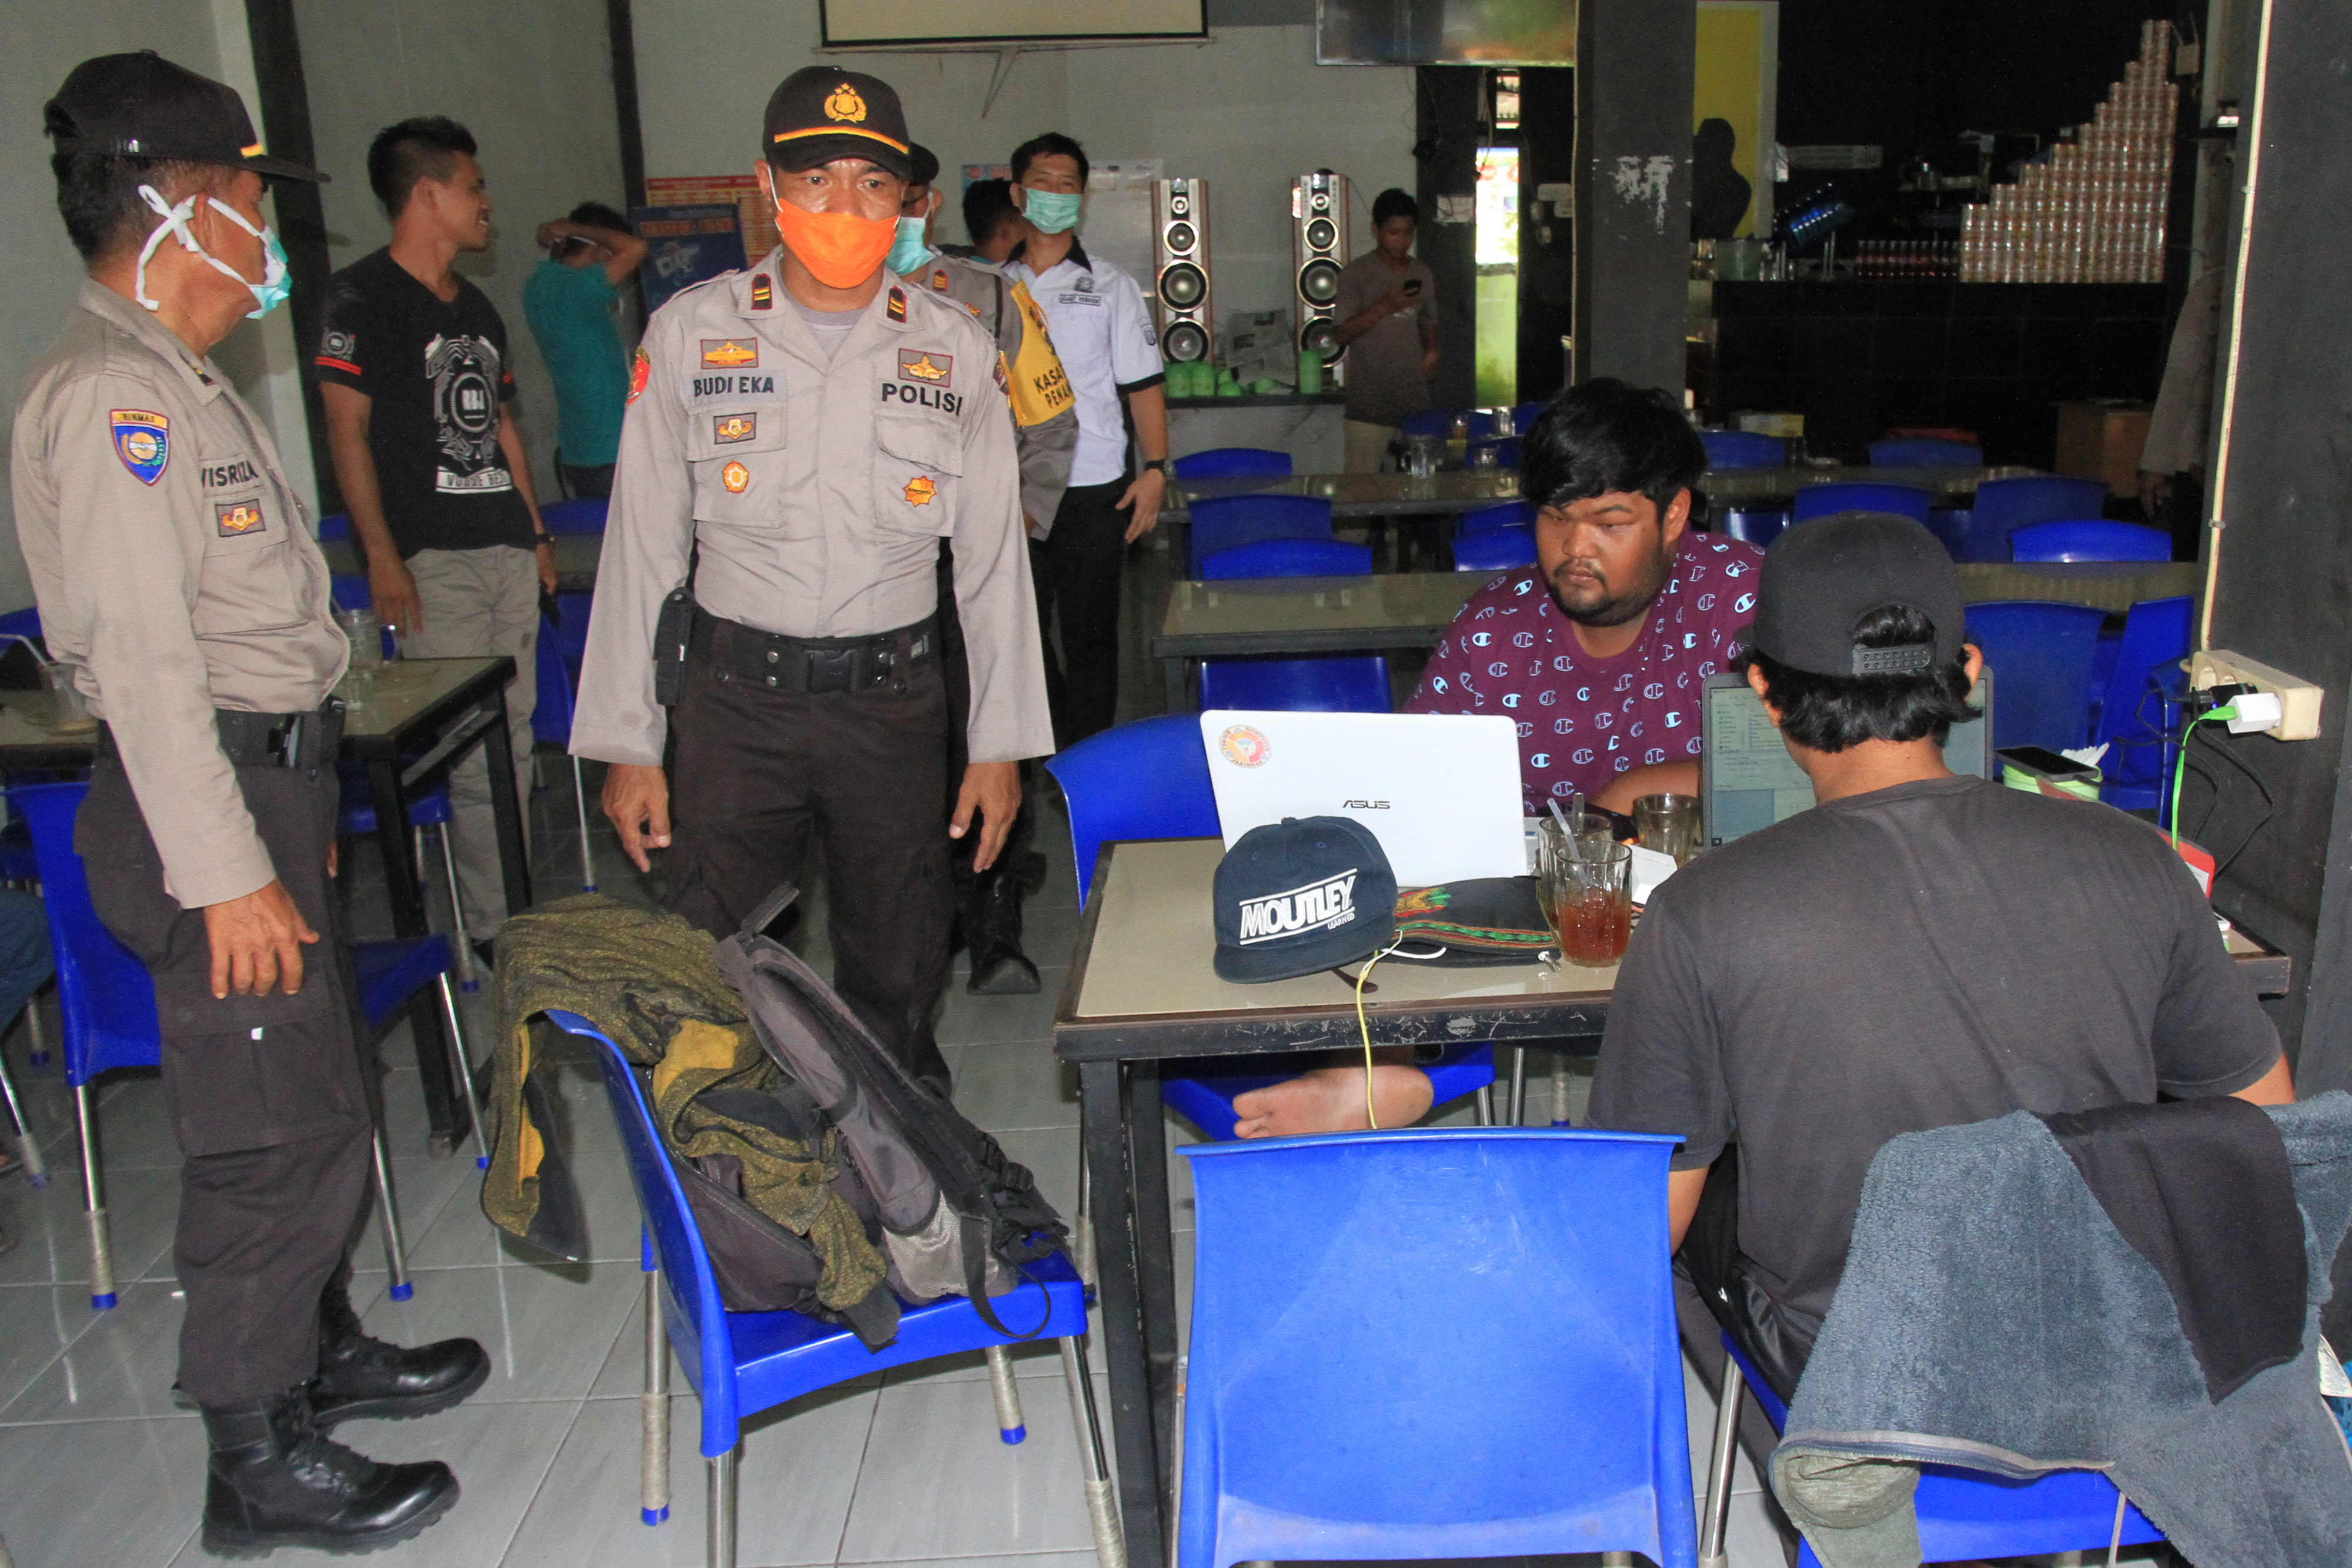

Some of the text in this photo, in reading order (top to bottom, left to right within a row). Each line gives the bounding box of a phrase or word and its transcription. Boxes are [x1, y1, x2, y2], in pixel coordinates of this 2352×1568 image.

[693, 376, 774, 397] BUDI EKA
[881, 383, 963, 417] POLISI
[1342, 800, 1391, 810] ASUS
[1240, 875, 1357, 940] MOUTLEY
